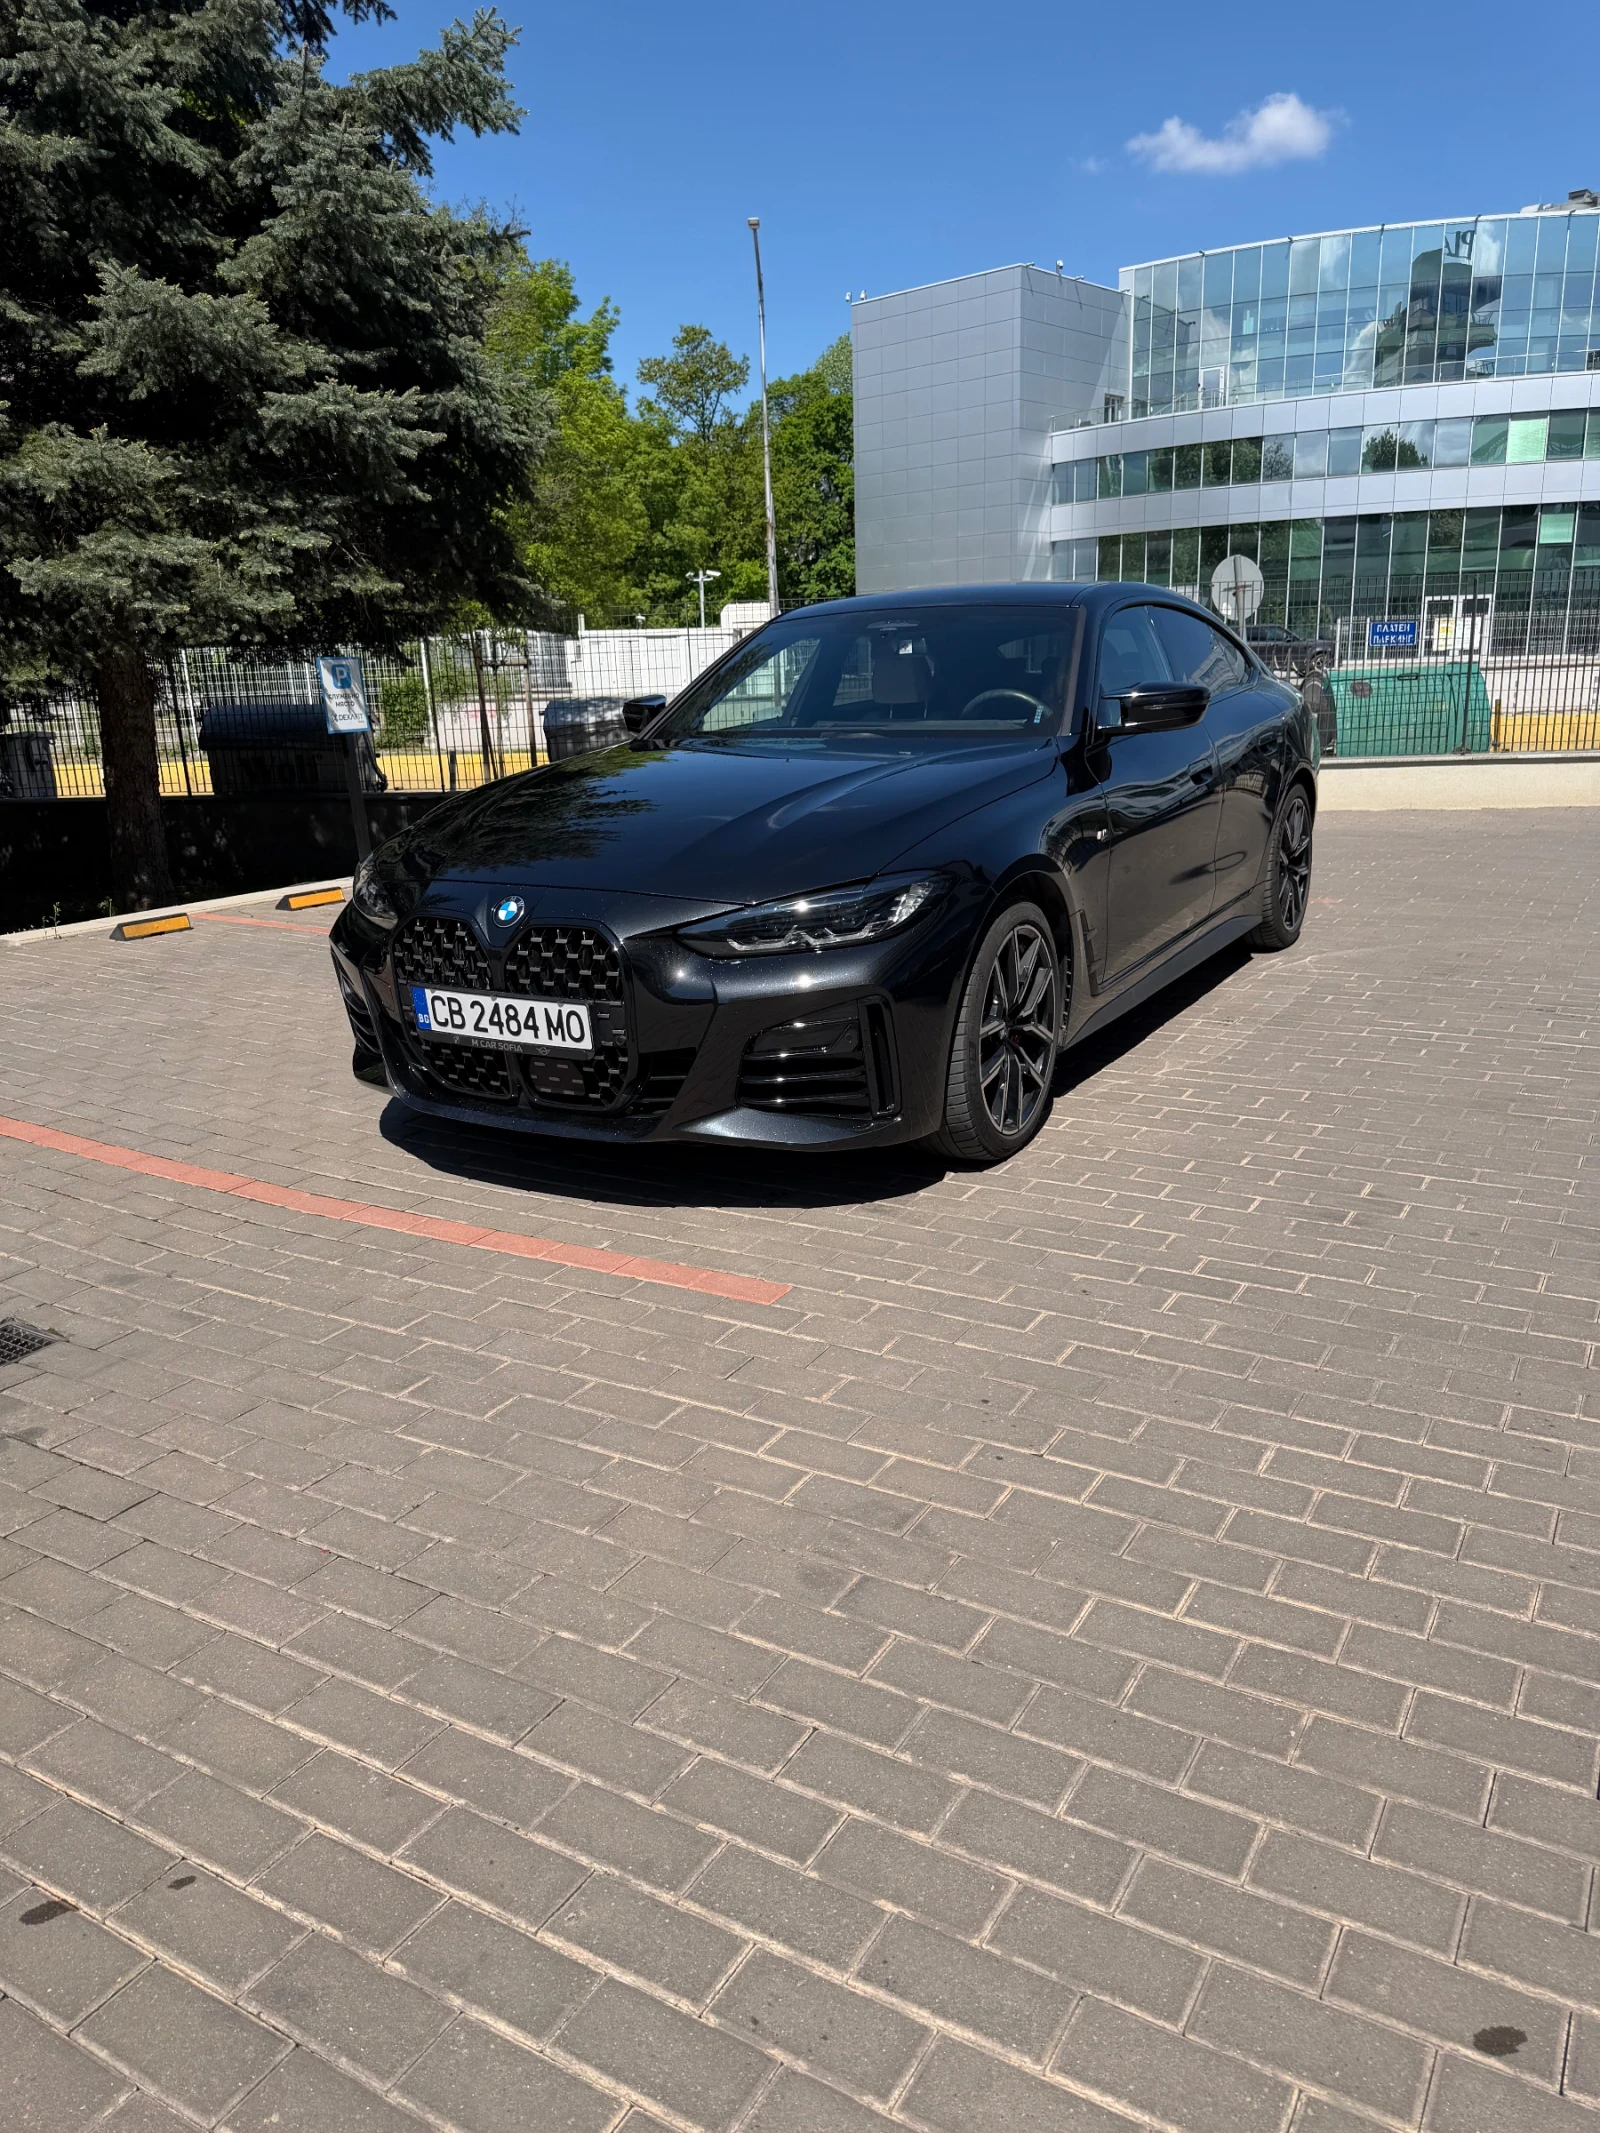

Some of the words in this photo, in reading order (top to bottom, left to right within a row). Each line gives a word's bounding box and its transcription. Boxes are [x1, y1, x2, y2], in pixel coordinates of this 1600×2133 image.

[1376, 623, 1410, 633] ПЛАТЕН
[335, 667, 347, 686] P
[418, 1013, 430, 1025] BG
[430, 995, 466, 1030] CB
[470, 1000, 540, 1040] 2484
[543, 1007, 586, 1044] MO
[471, 1038, 479, 1047] M
[480, 1039, 497, 1049] CAR
[498, 1042, 524, 1053] SOFIA
